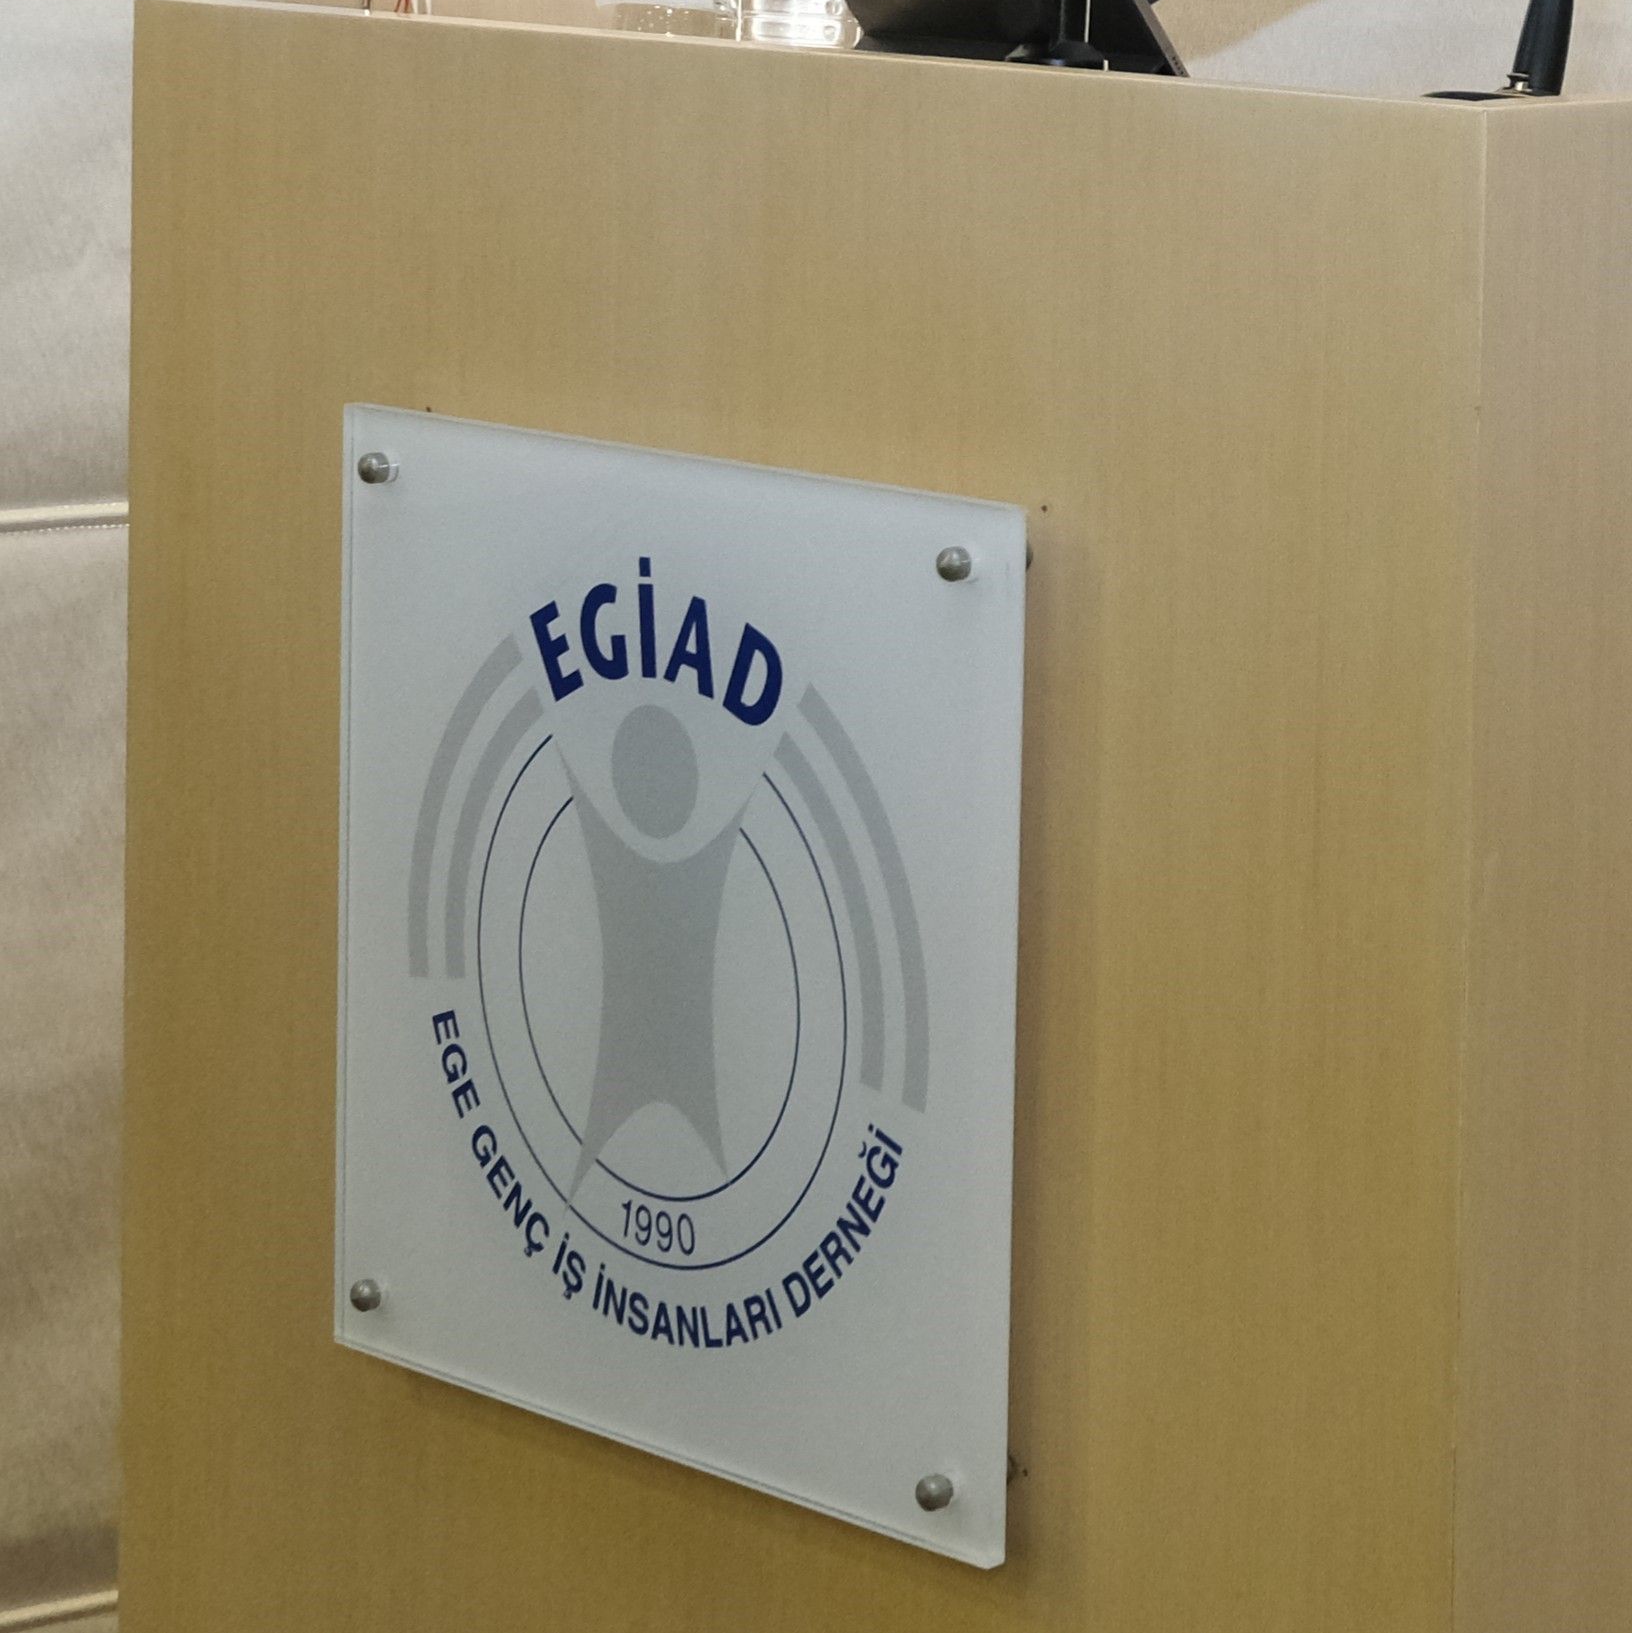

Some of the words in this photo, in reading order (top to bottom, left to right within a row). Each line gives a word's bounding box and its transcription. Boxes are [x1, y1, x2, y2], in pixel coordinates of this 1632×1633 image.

[530, 556, 783, 726] EGİAD
[432, 1010, 481, 1118] EGE
[471, 1125, 550, 1257] GENÇ
[552, 1232, 586, 1298] İŞ
[592, 1263, 783, 1348] İNSANLARI
[782, 1123, 903, 1317] DERNEĞİ
[621, 1200, 695, 1256] 1990
